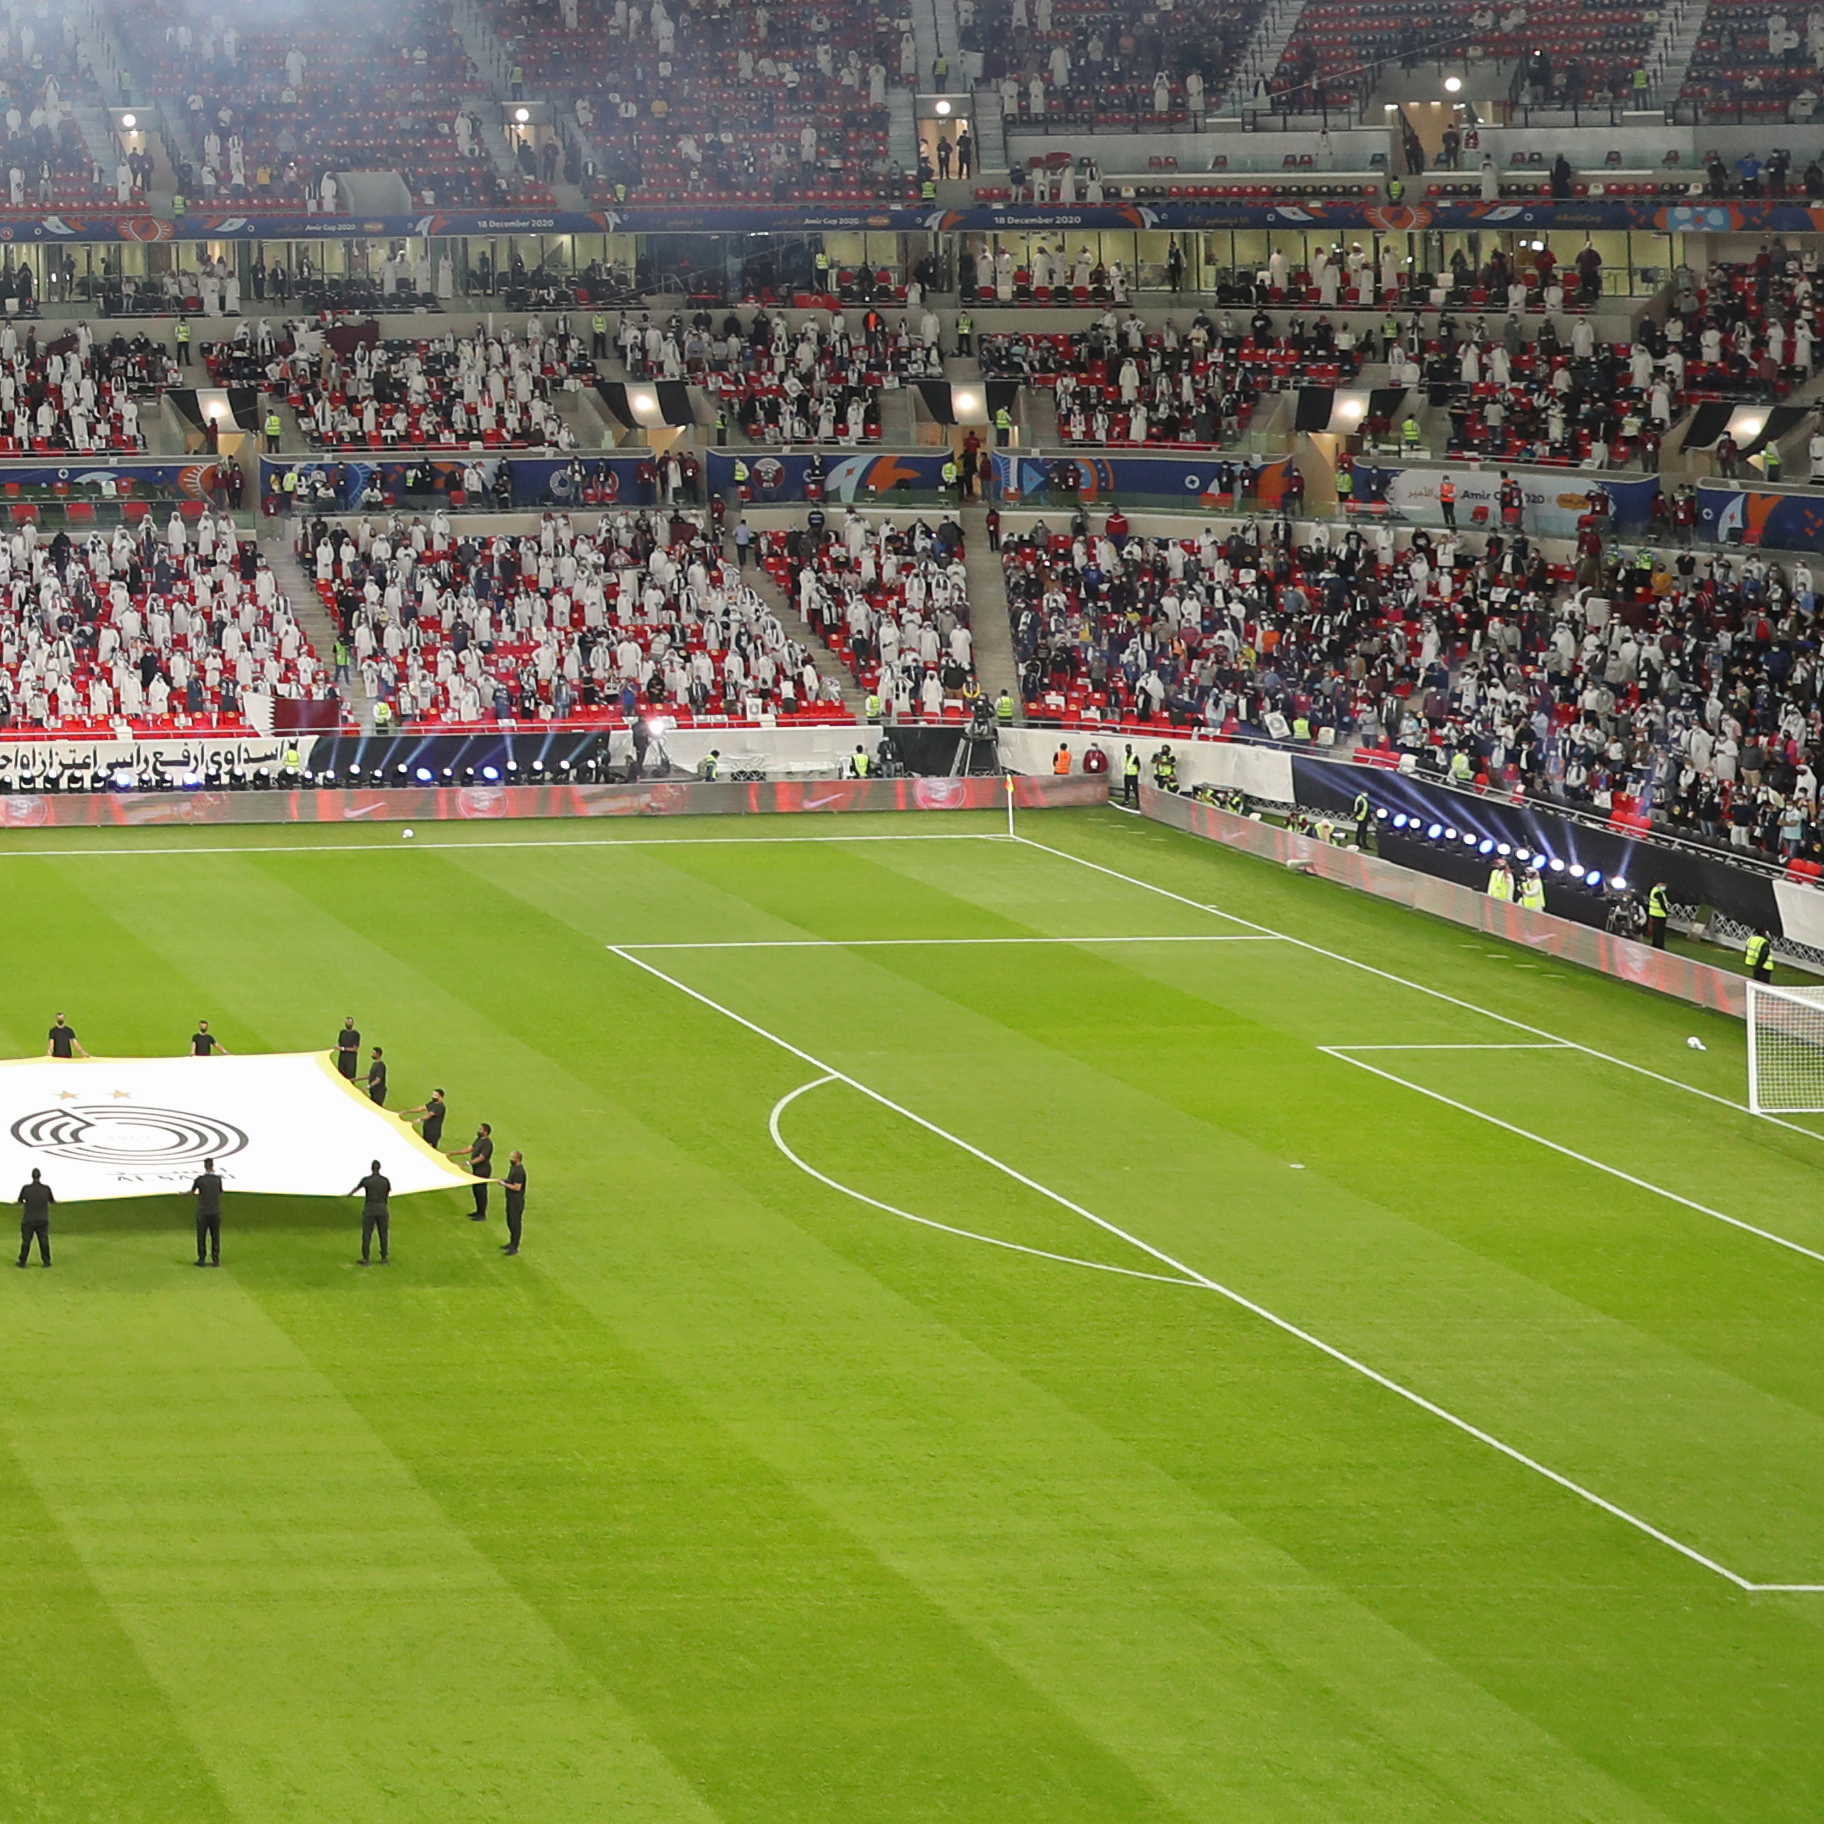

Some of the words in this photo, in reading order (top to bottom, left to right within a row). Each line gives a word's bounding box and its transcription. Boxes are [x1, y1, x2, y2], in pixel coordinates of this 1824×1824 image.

[477, 219, 487, 228] 18
[487, 219, 529, 228] December
[530, 219, 554, 228] 2020
[803, 217, 822, 226] Amir
[822, 217, 837, 226] Cup
[838, 217, 859, 226] 2020
[995, 215, 1005, 225] 18
[1006, 215, 1053, 225] December
[1055, 215, 1081, 225] 2020
[305, 223, 321, 232] Amir
[322, 223, 336, 232] Cup
[336, 223, 356, 232] 2020
[1461, 490, 1491, 500] Amir
